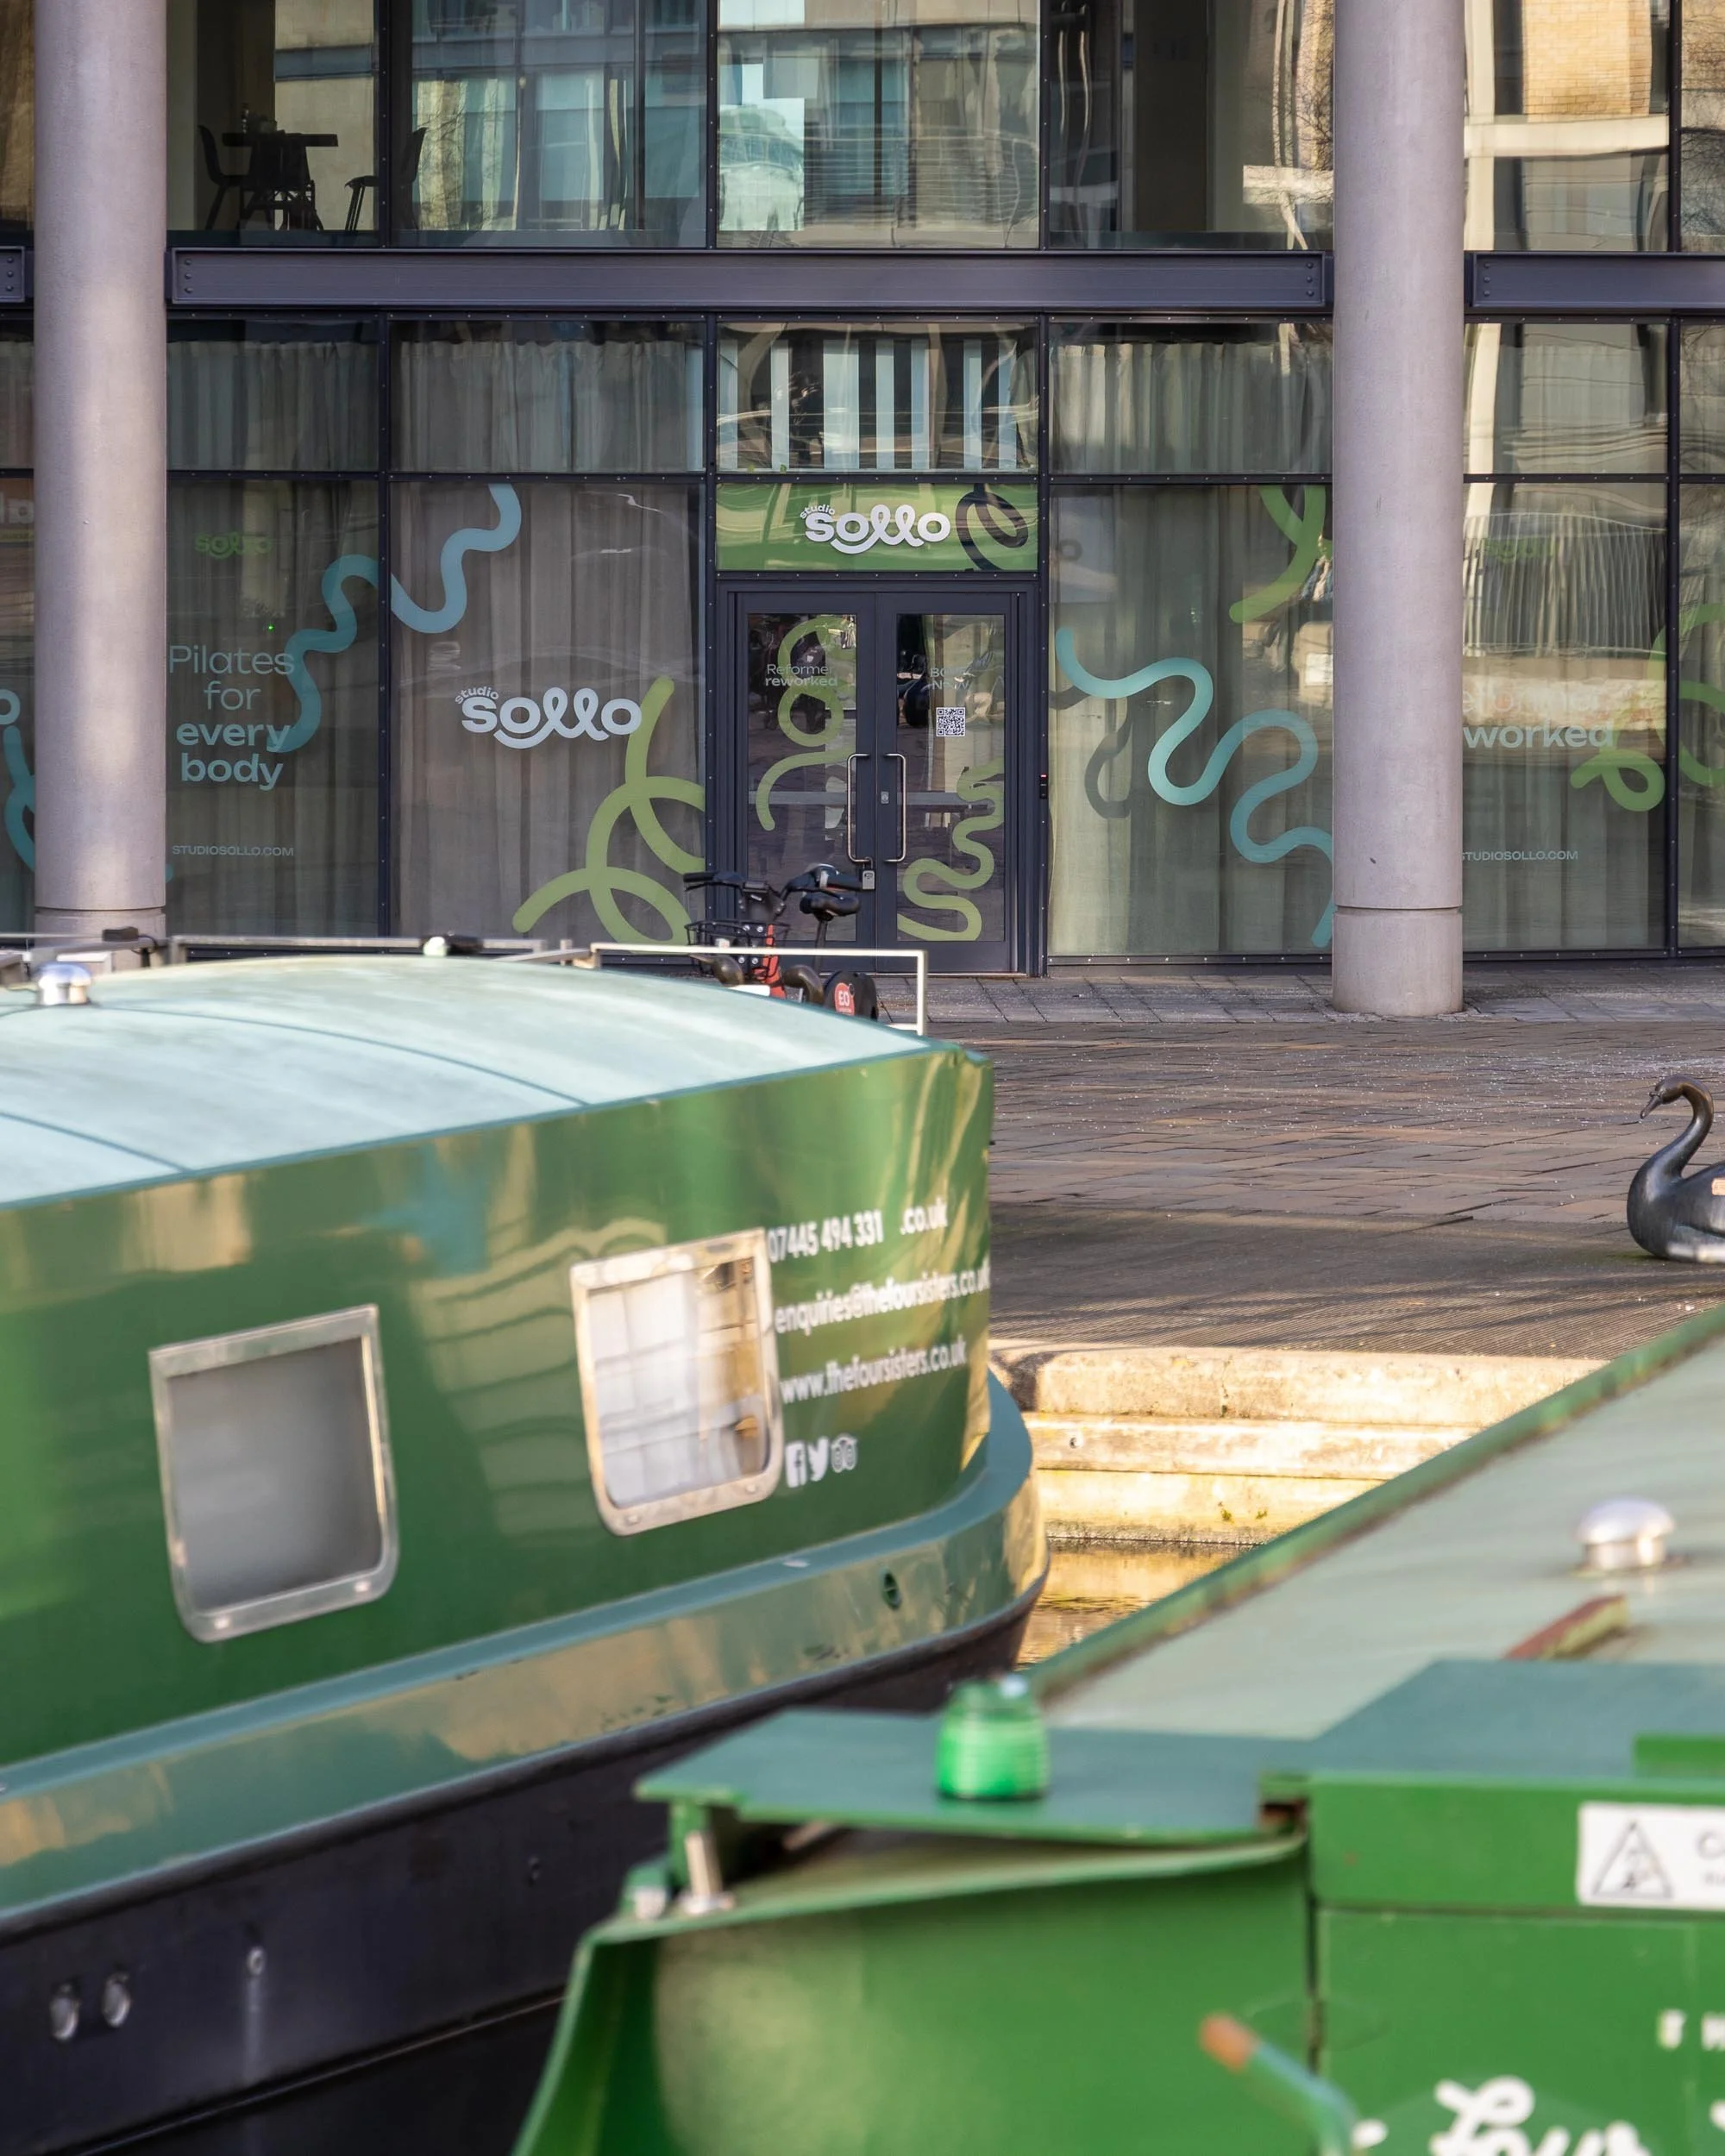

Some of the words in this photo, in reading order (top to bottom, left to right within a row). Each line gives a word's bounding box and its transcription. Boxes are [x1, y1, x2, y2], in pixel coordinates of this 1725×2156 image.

[800, 504, 835, 519] studio
[805, 505, 950, 555] sollo
[169, 644, 295, 675] Pilates
[204, 680, 261, 711] for
[455, 686, 499, 705] studio
[765, 675, 837, 686] reworked
[461, 686, 643, 749] sollo
[176, 722, 291, 753] every
[180, 752, 284, 791] body
[172, 845, 294, 856] STUDIOSOLLO.COM
[767, 1220, 819, 1263] 07445
[820, 1213, 853, 1252] 494
[853, 1208, 884, 1248] 331
